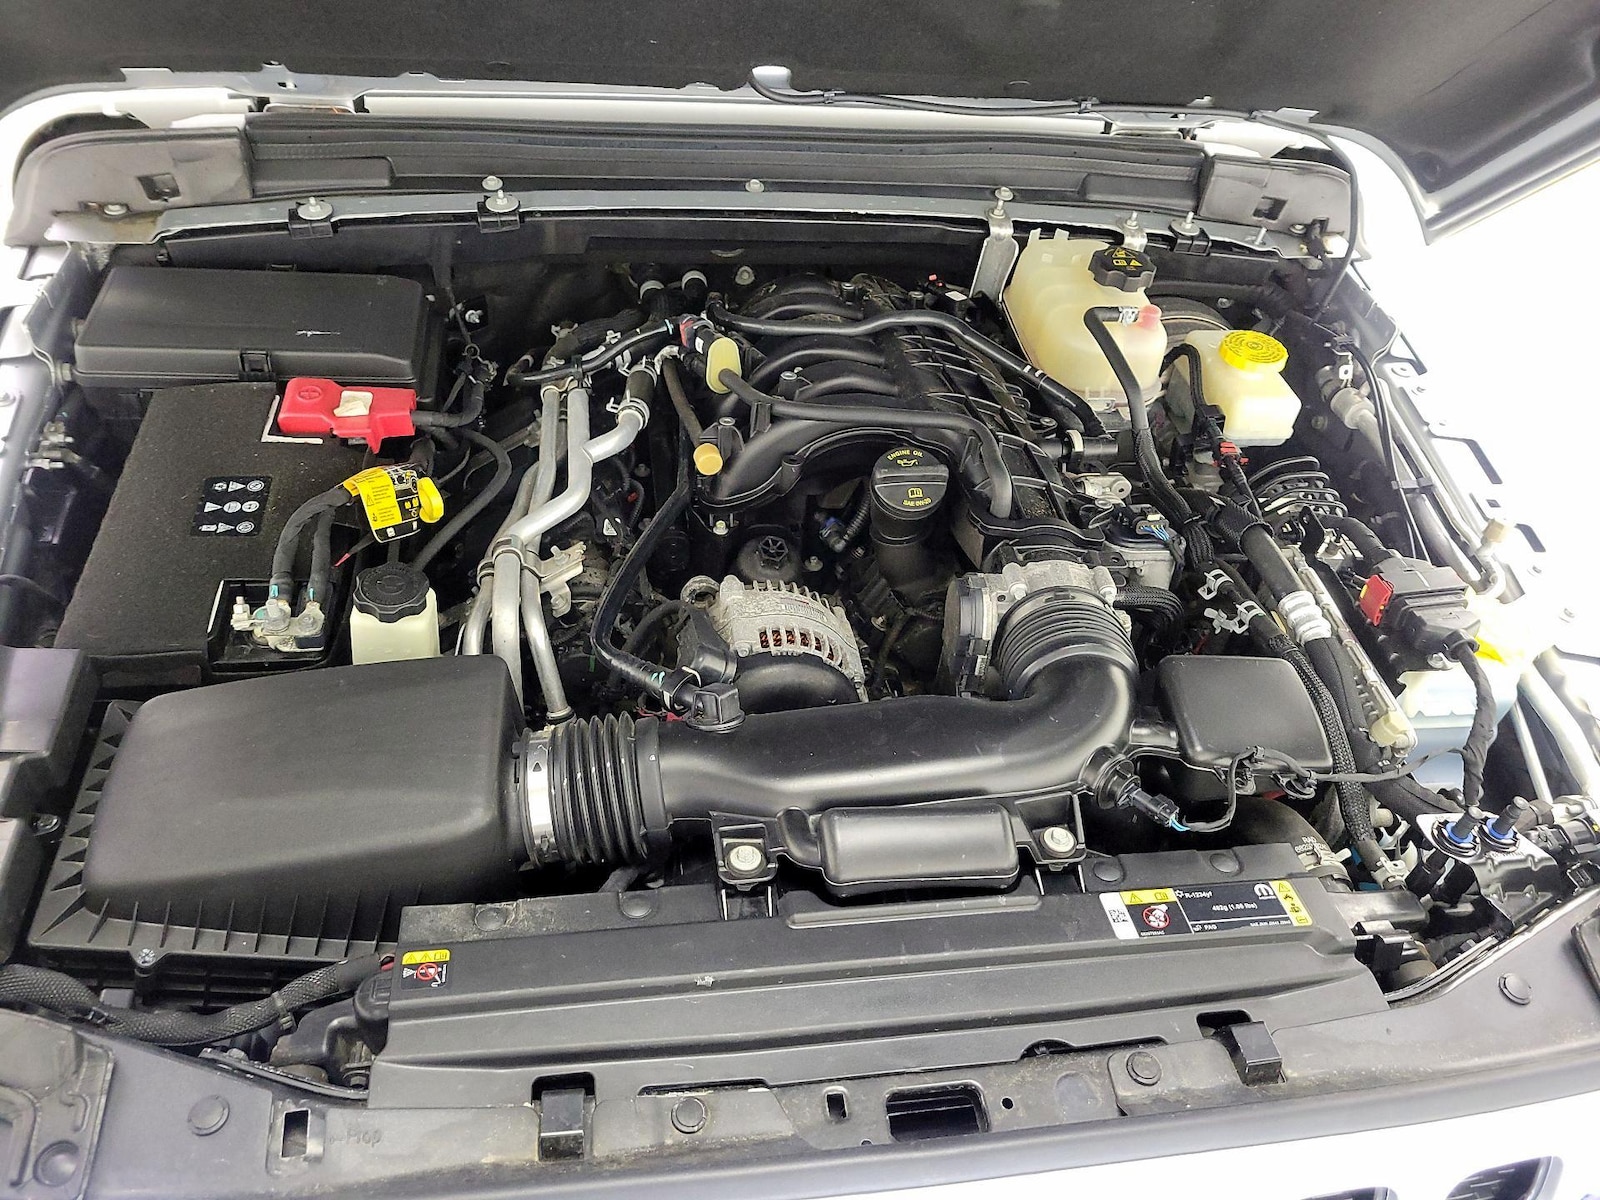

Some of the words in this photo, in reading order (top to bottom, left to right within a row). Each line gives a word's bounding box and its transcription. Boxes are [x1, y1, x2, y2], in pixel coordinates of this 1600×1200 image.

[887, 449, 911, 460] ENGINE
[912, 450, 924, 458] OIL
[902, 499, 915, 507] SAE
